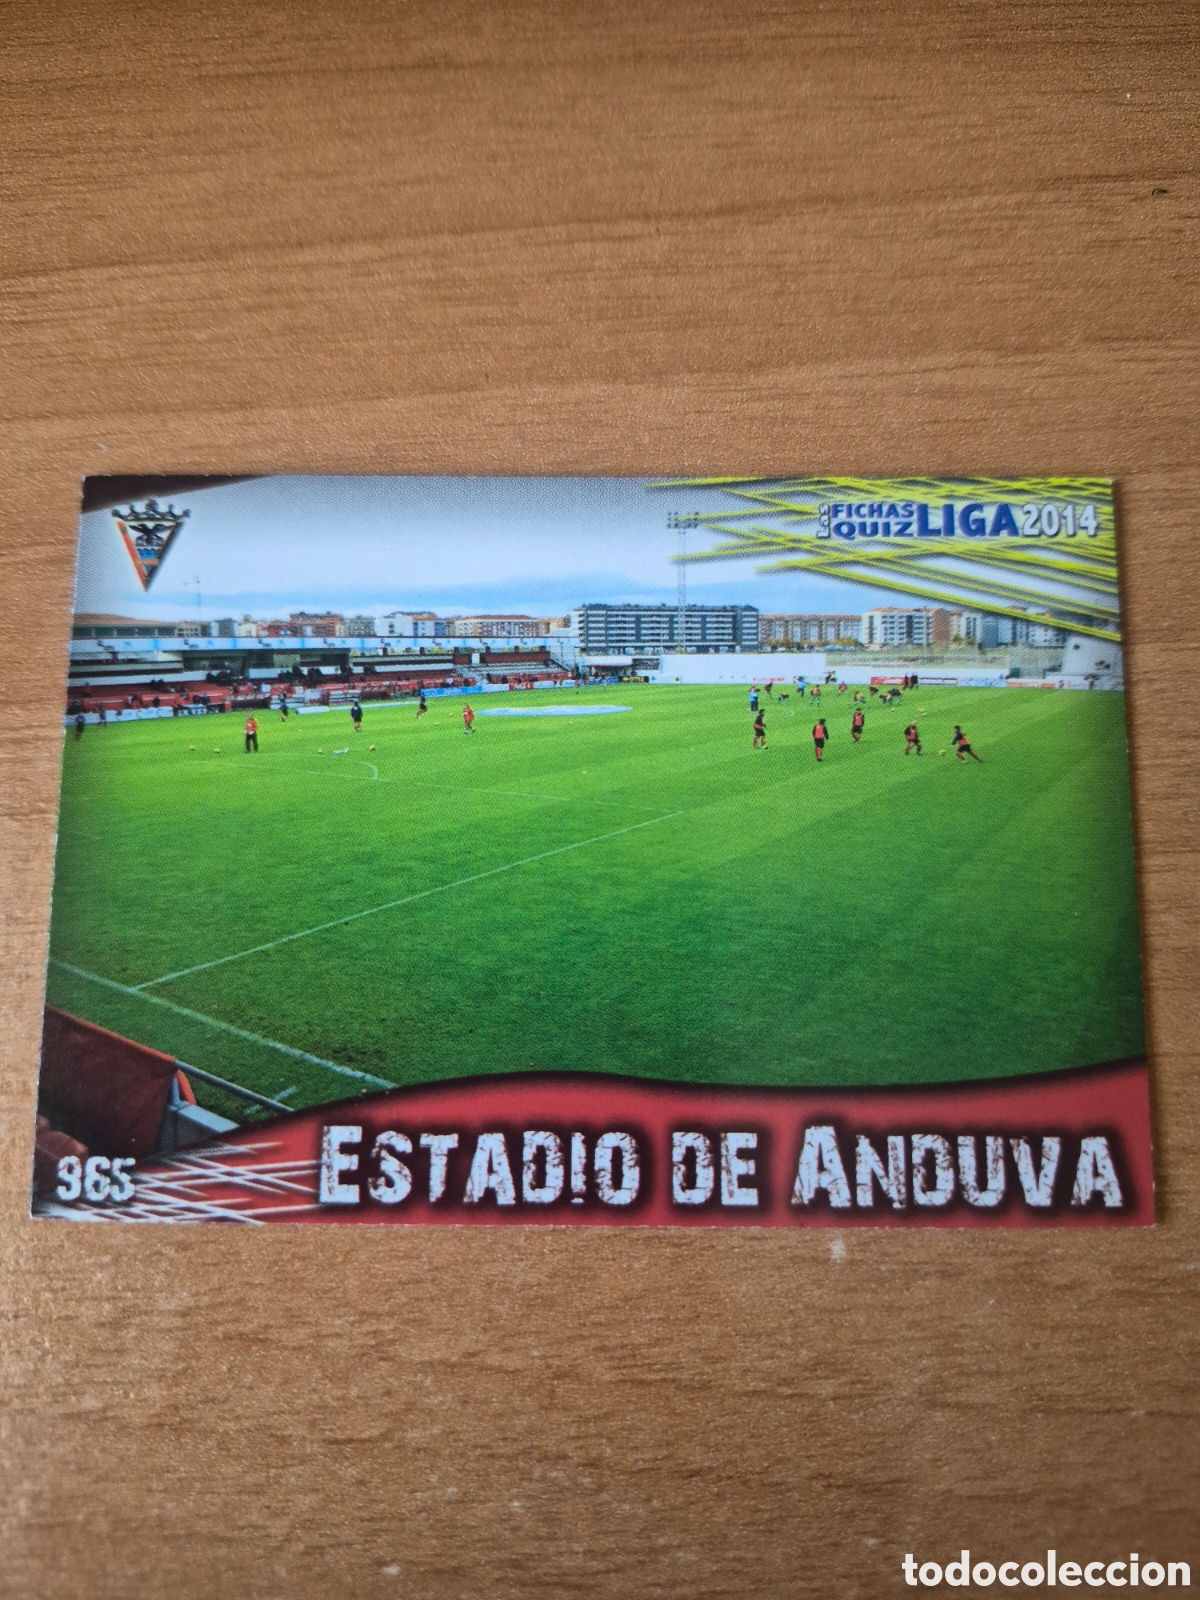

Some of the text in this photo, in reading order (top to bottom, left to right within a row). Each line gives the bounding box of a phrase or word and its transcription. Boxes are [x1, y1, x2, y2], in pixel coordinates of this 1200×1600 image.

[830, 502, 915, 519] FICHAS
[916, 503, 1098, 538] LIGA 2014
[831, 520, 915, 541] QUIZ
[56, 1155, 136, 1201] 965
[319, 1124, 1124, 1209] ESTADIO DE ANDUVA
